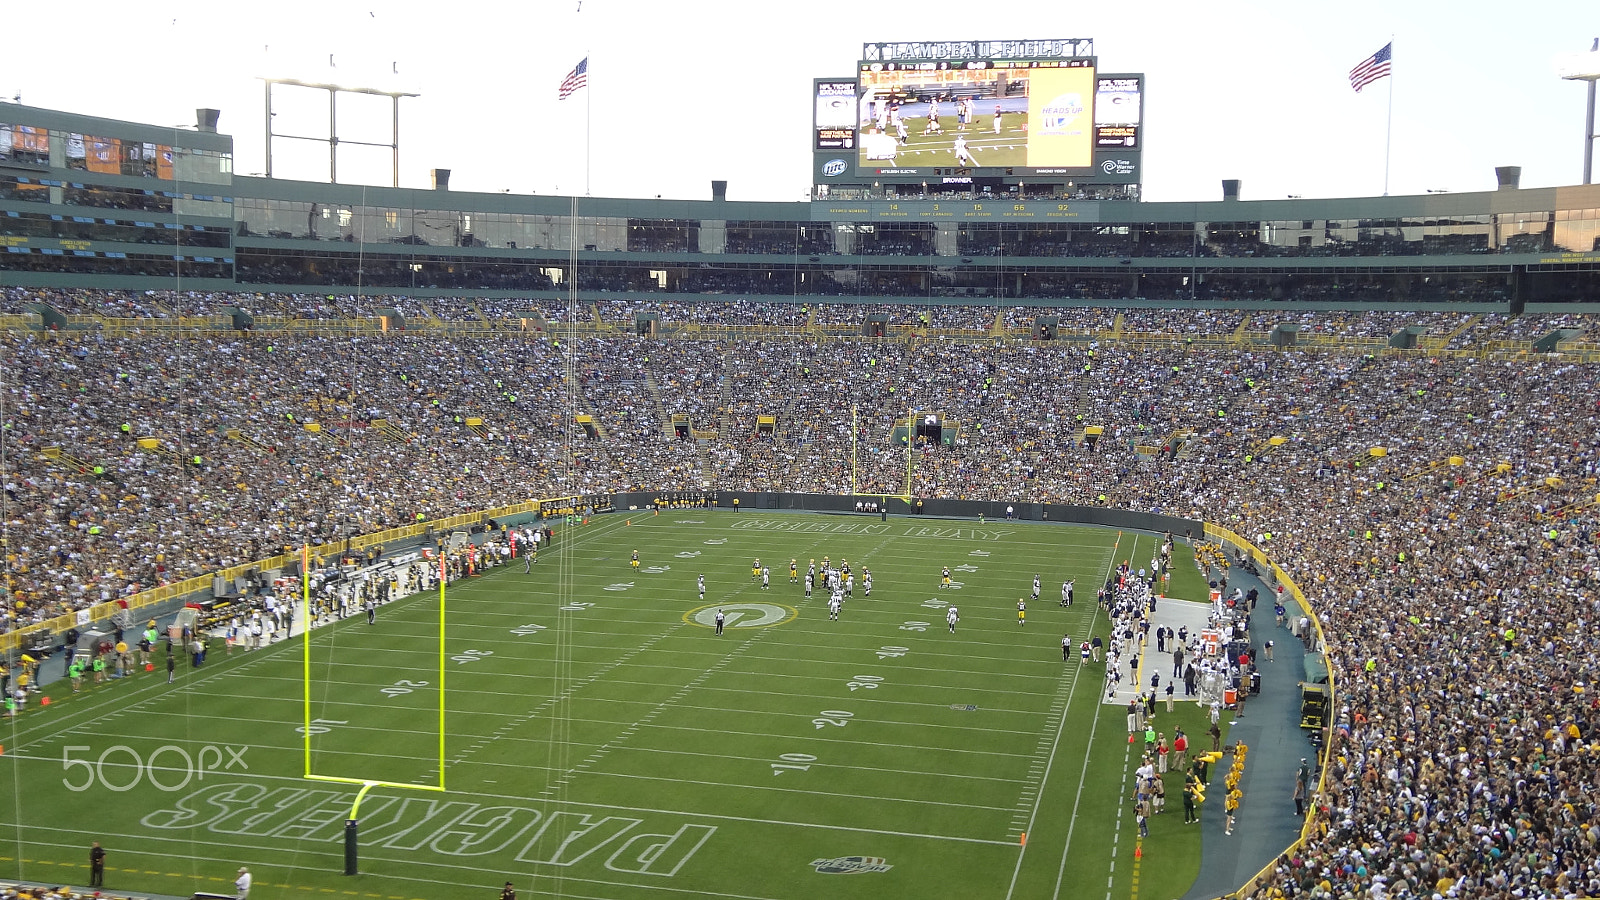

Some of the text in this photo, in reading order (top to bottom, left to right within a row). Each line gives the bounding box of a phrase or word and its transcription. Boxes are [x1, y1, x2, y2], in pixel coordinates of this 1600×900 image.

[892, 40, 1064, 59] LAMBEAU FIELD
[450, 649, 494, 663] 30
[380, 679, 429, 696] 20
[846, 675, 885, 690] 30
[295, 718, 348, 735] 10
[811, 710, 855, 727] 20
[770, 753, 818, 772] 10
[140, 782, 718, 878] PACKERS
